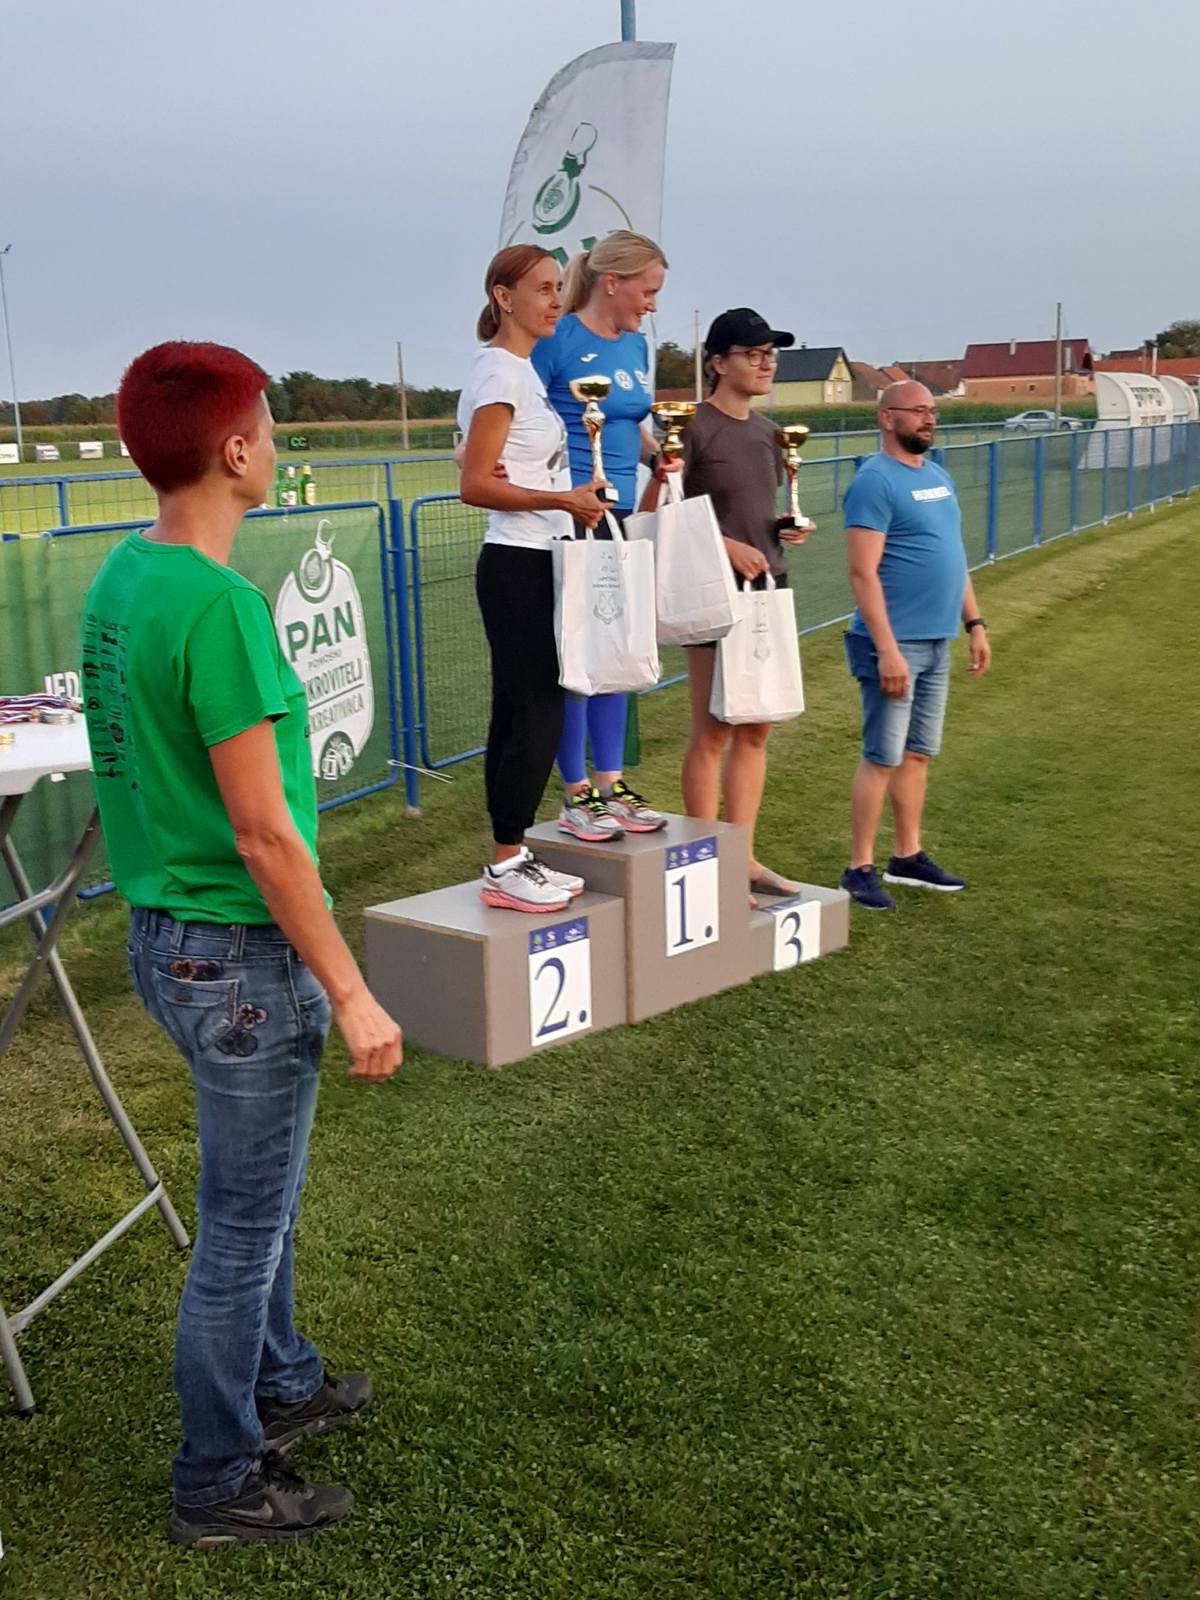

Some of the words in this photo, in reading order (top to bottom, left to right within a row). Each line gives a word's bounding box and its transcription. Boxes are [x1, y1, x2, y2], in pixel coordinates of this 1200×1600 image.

[285, 601, 356, 662] PAN
[302, 657, 363, 702] KROVITELJ
[671, 875, 713, 948] 1.
[780, 911, 803, 965] 3
[534, 957, 587, 1038] 2.
